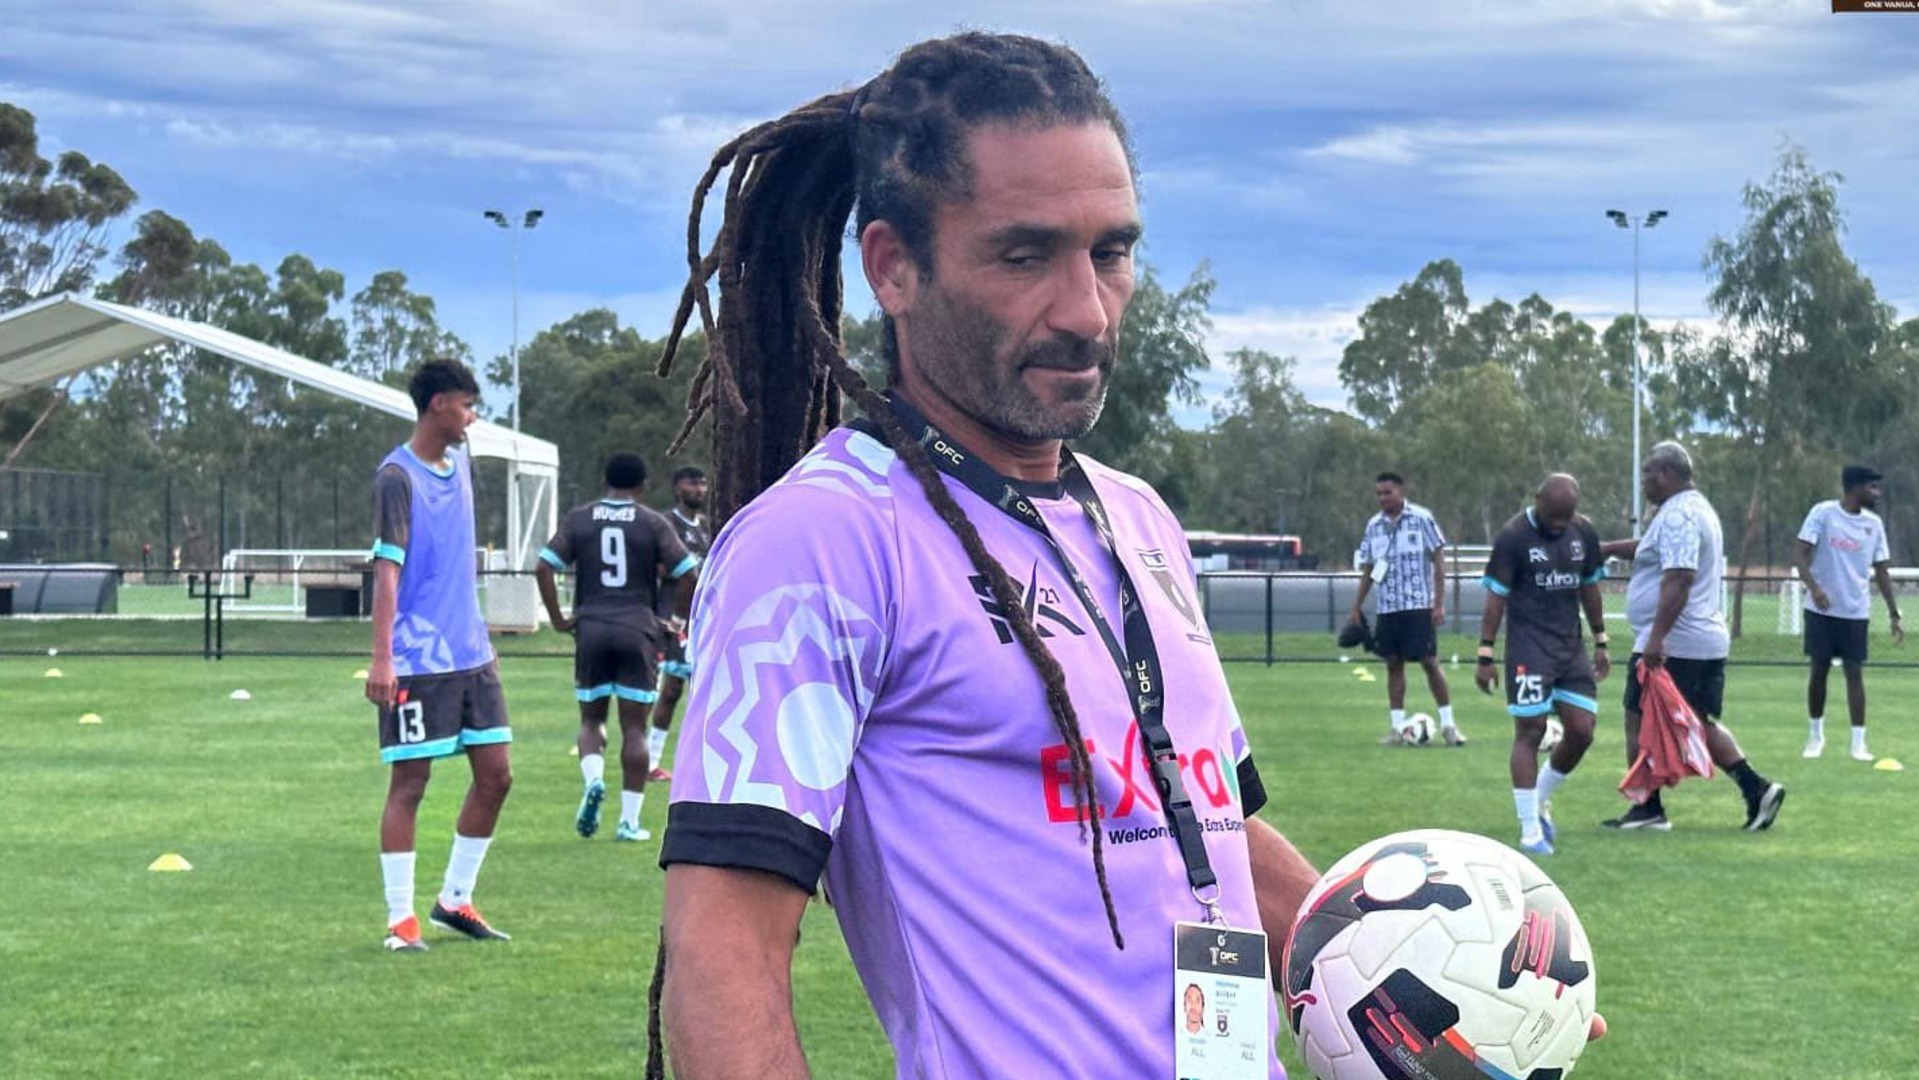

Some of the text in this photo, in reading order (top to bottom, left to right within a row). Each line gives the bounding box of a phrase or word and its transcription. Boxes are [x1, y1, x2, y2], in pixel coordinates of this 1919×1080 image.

[933, 440, 964, 465] OFC
[592, 505, 636, 522] HUGHES
[601, 527, 627, 587] 9
[1135, 659, 1151, 693] OFC
[1515, 674, 1543, 704] 25
[398, 700, 426, 743] 13
